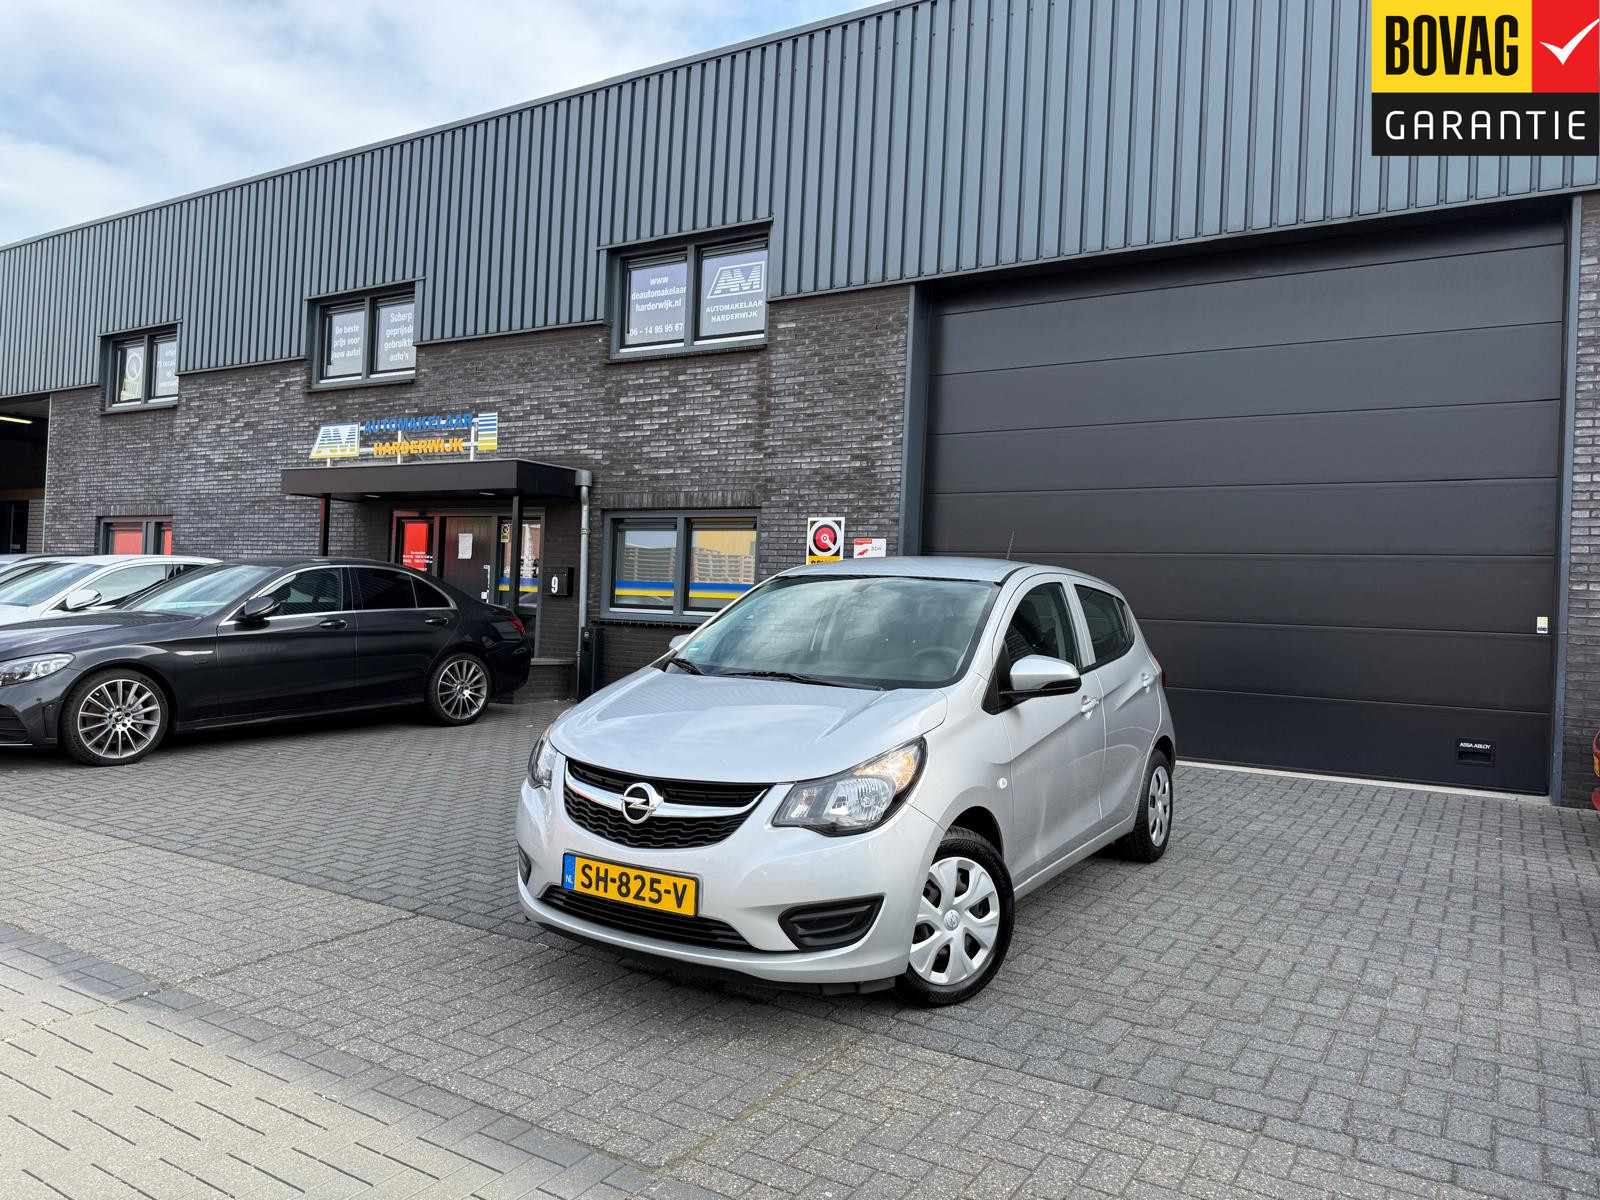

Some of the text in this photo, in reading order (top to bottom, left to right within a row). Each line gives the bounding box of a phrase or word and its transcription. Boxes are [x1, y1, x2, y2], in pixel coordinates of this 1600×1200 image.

[650, 276, 668, 286] www
[631, 286, 687, 301] deautomakelaar
[635, 299, 682, 312] harderwijk.nl
[705, 300, 763, 313] AUTOMAKELAAR
[390, 312, 412, 322] Scherp
[711, 310, 758, 323] HARDERWIJK
[344, 324, 360, 333] beste
[630, 328, 638, 336] 06
[645, 326, 653, 335] 14
[654, 325, 663, 334] 95
[664, 324, 673, 333] 95
[674, 322, 684, 332] 67
[333, 336, 360, 350] prijs voor
[389, 352, 409, 362] auto's
[364, 413, 473, 434] AUTOMAKELAAR
[373, 438, 464, 456] HARDERWIJK
[551, 576, 558, 594] 9
[565, 864, 687, 909] NL SH-825-V
